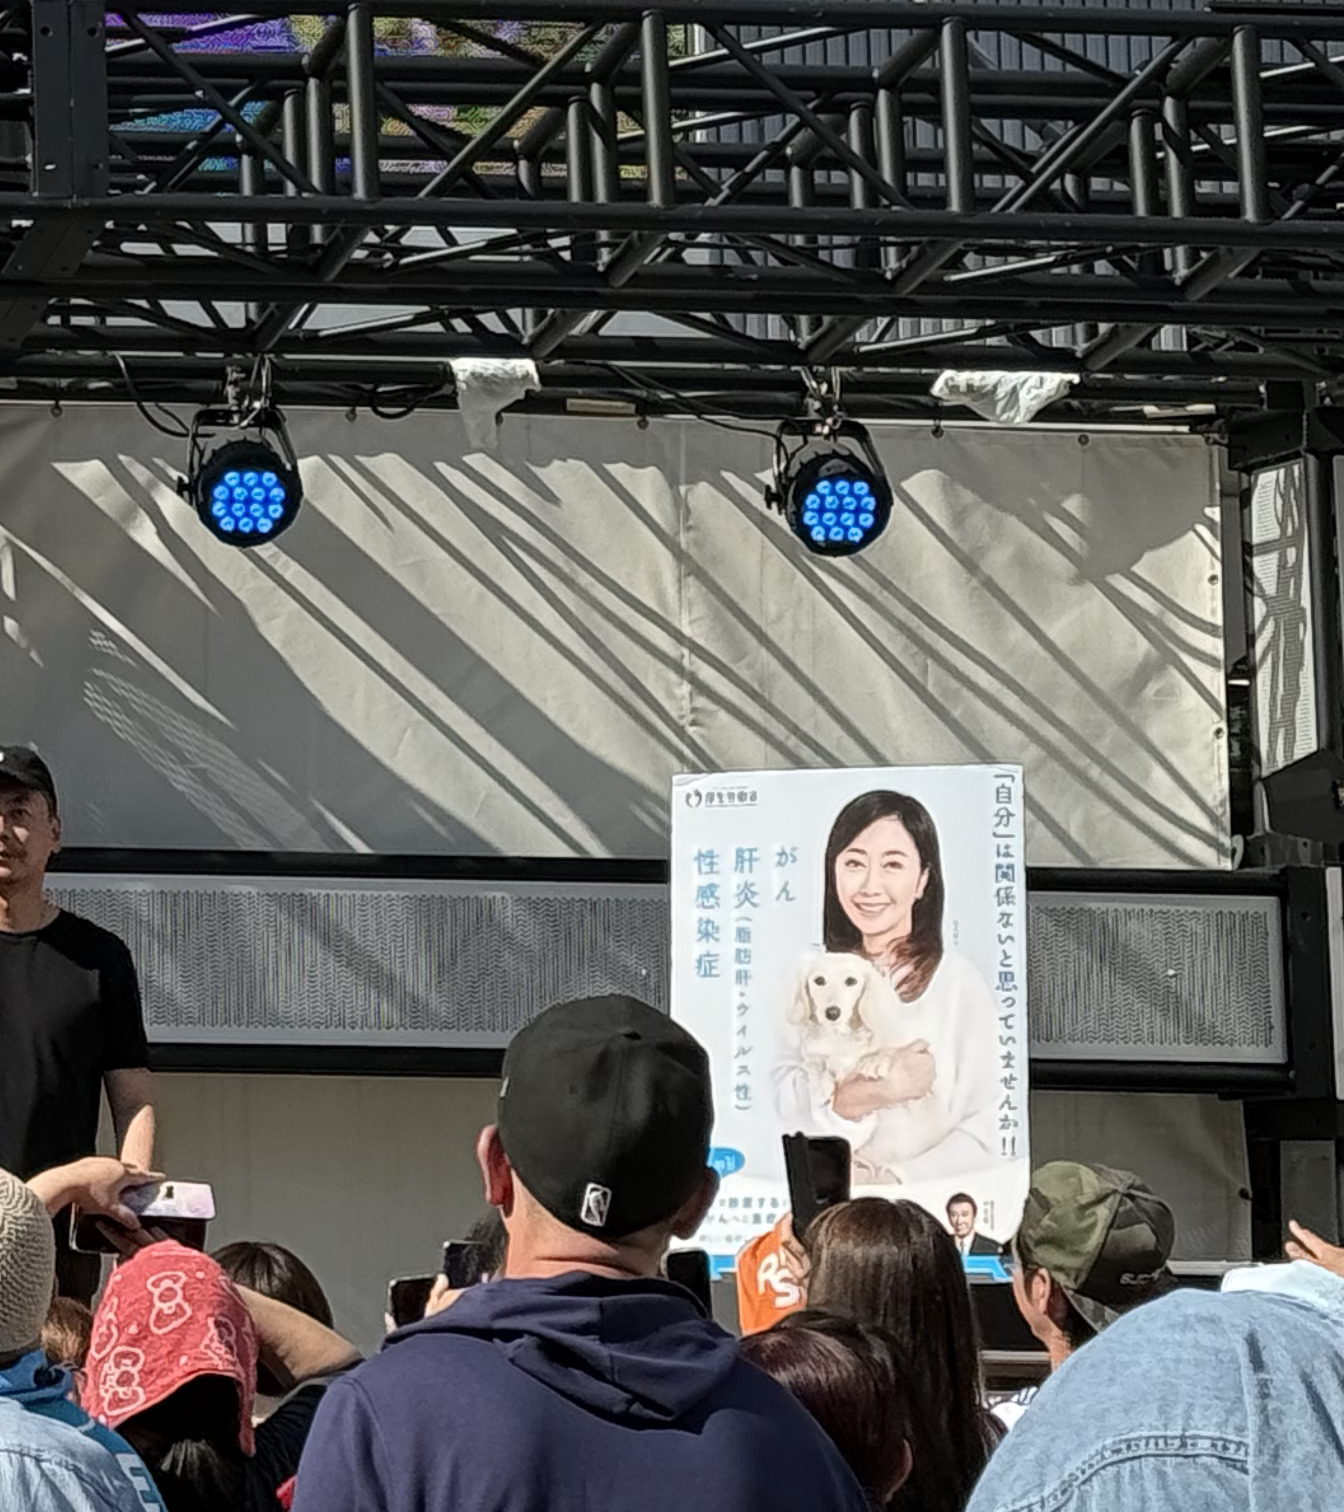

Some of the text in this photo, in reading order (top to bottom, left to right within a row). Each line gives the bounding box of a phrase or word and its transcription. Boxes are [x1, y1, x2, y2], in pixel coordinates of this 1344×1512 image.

[694, 848, 721, 979] 性感染症
[774, 845, 799, 902] がん
